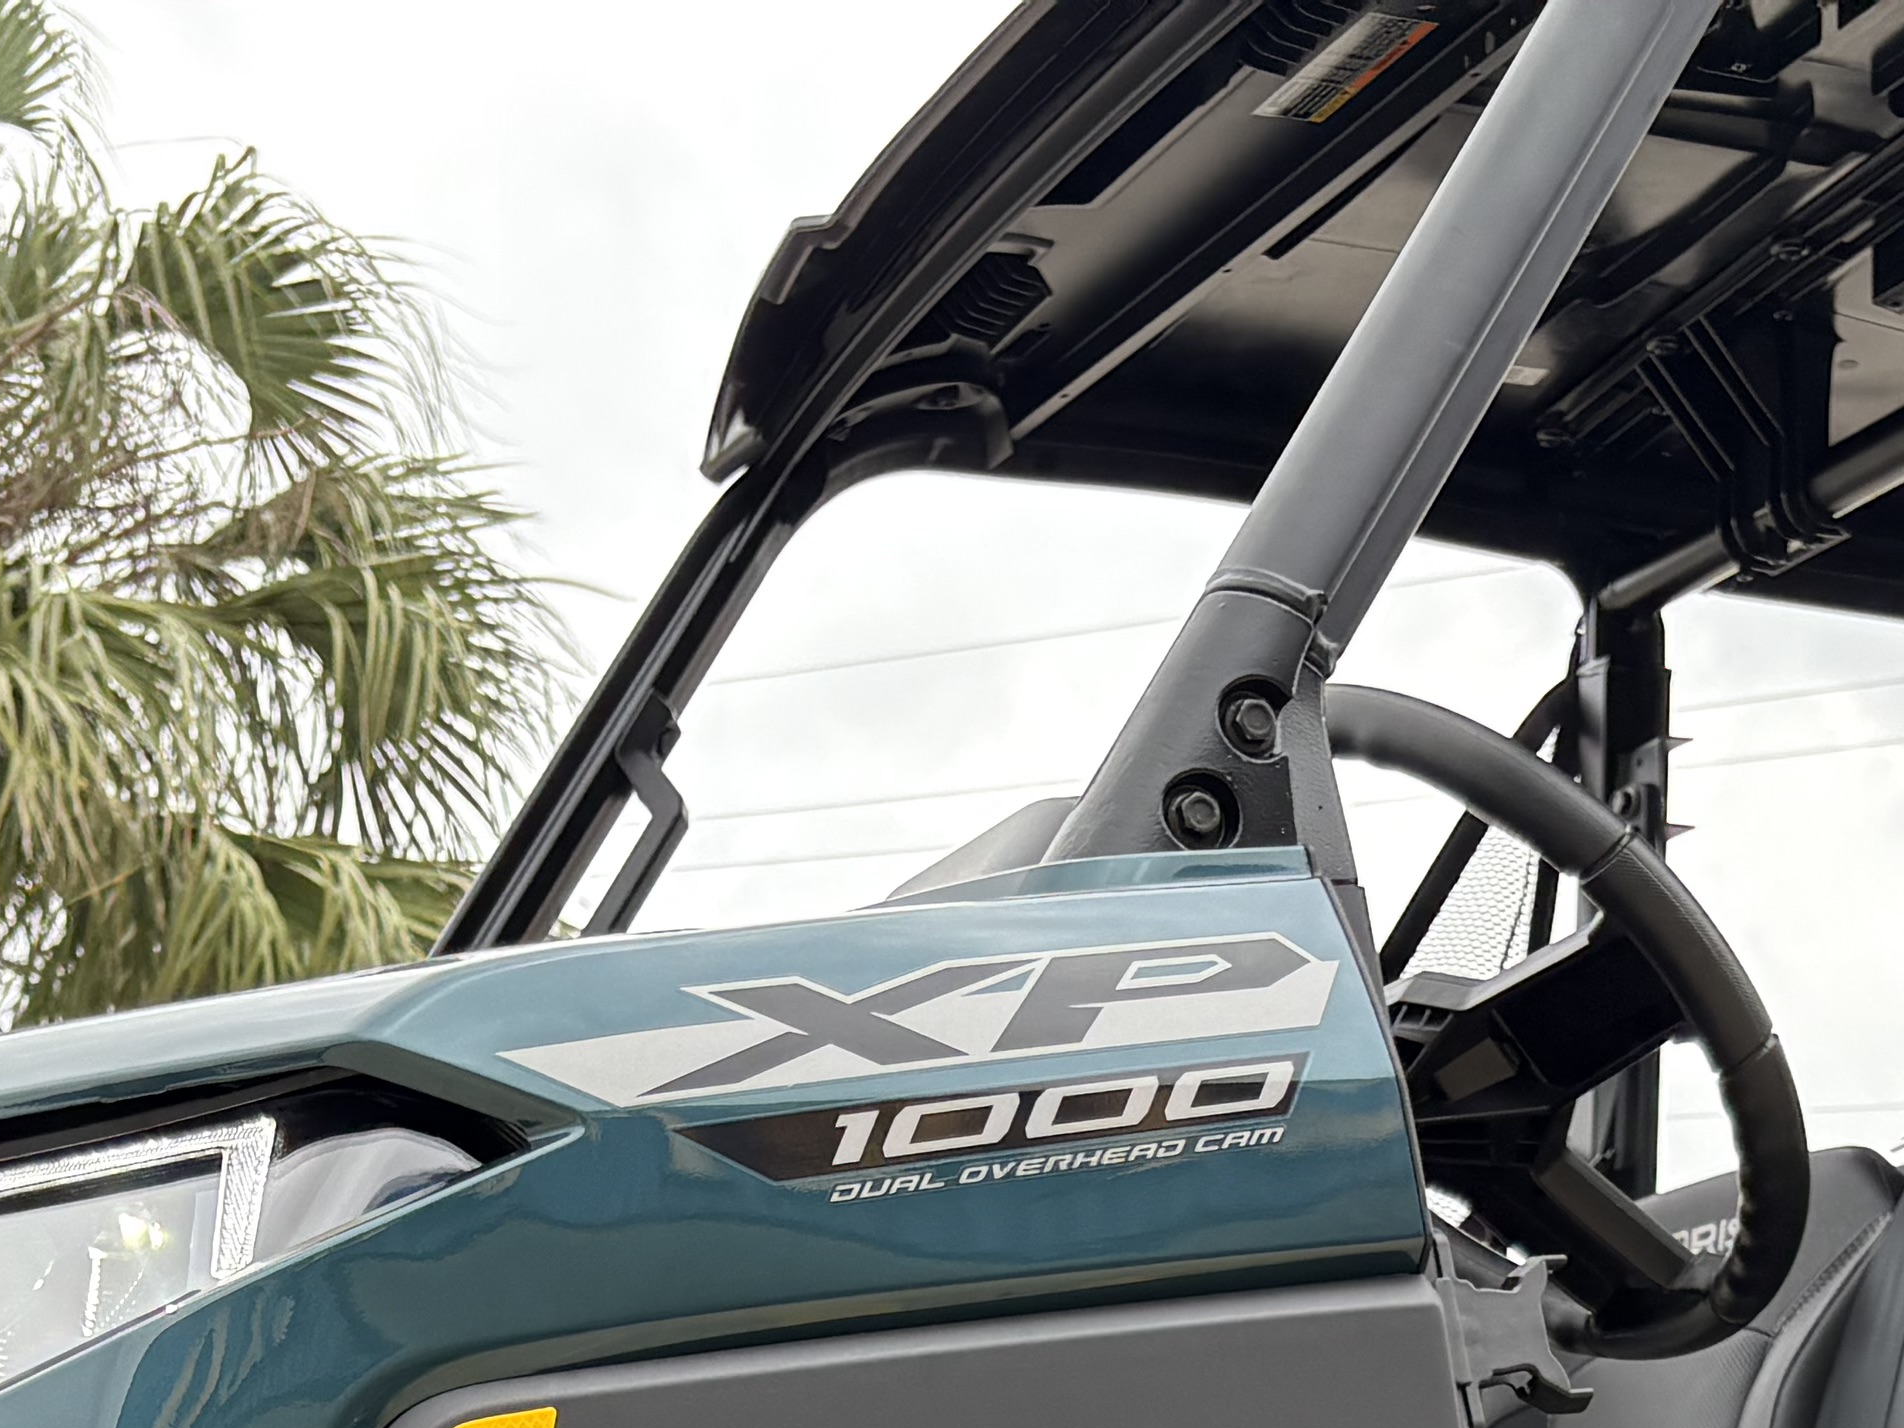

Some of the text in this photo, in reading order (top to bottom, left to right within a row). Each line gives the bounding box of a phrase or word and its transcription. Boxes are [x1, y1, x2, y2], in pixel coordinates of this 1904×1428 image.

[634, 933, 1314, 1098] XP
[829, 1060, 1295, 1166] 1000
[829, 1124, 1287, 1203] DUAL OVERHEAD CAM
